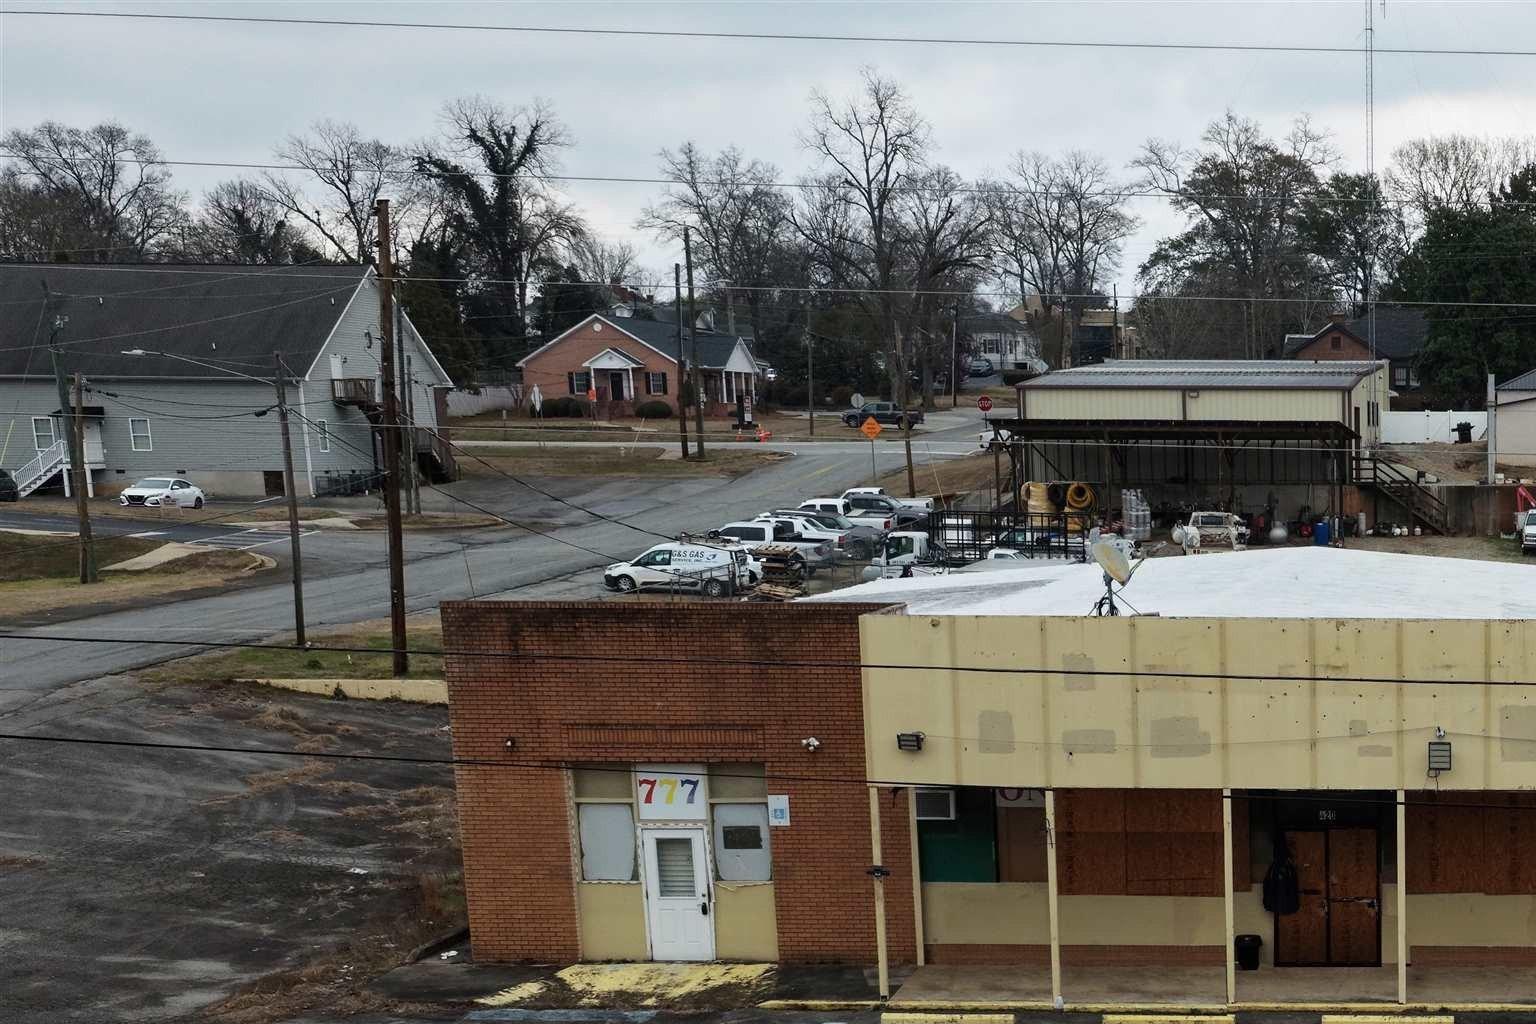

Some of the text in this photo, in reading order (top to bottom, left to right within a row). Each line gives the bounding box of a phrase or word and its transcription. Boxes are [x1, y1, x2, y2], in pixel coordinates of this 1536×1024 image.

[979, 400, 991, 408] STOP
[672, 550, 705, 559] G&S GAS
[638, 778, 699, 805] 777
